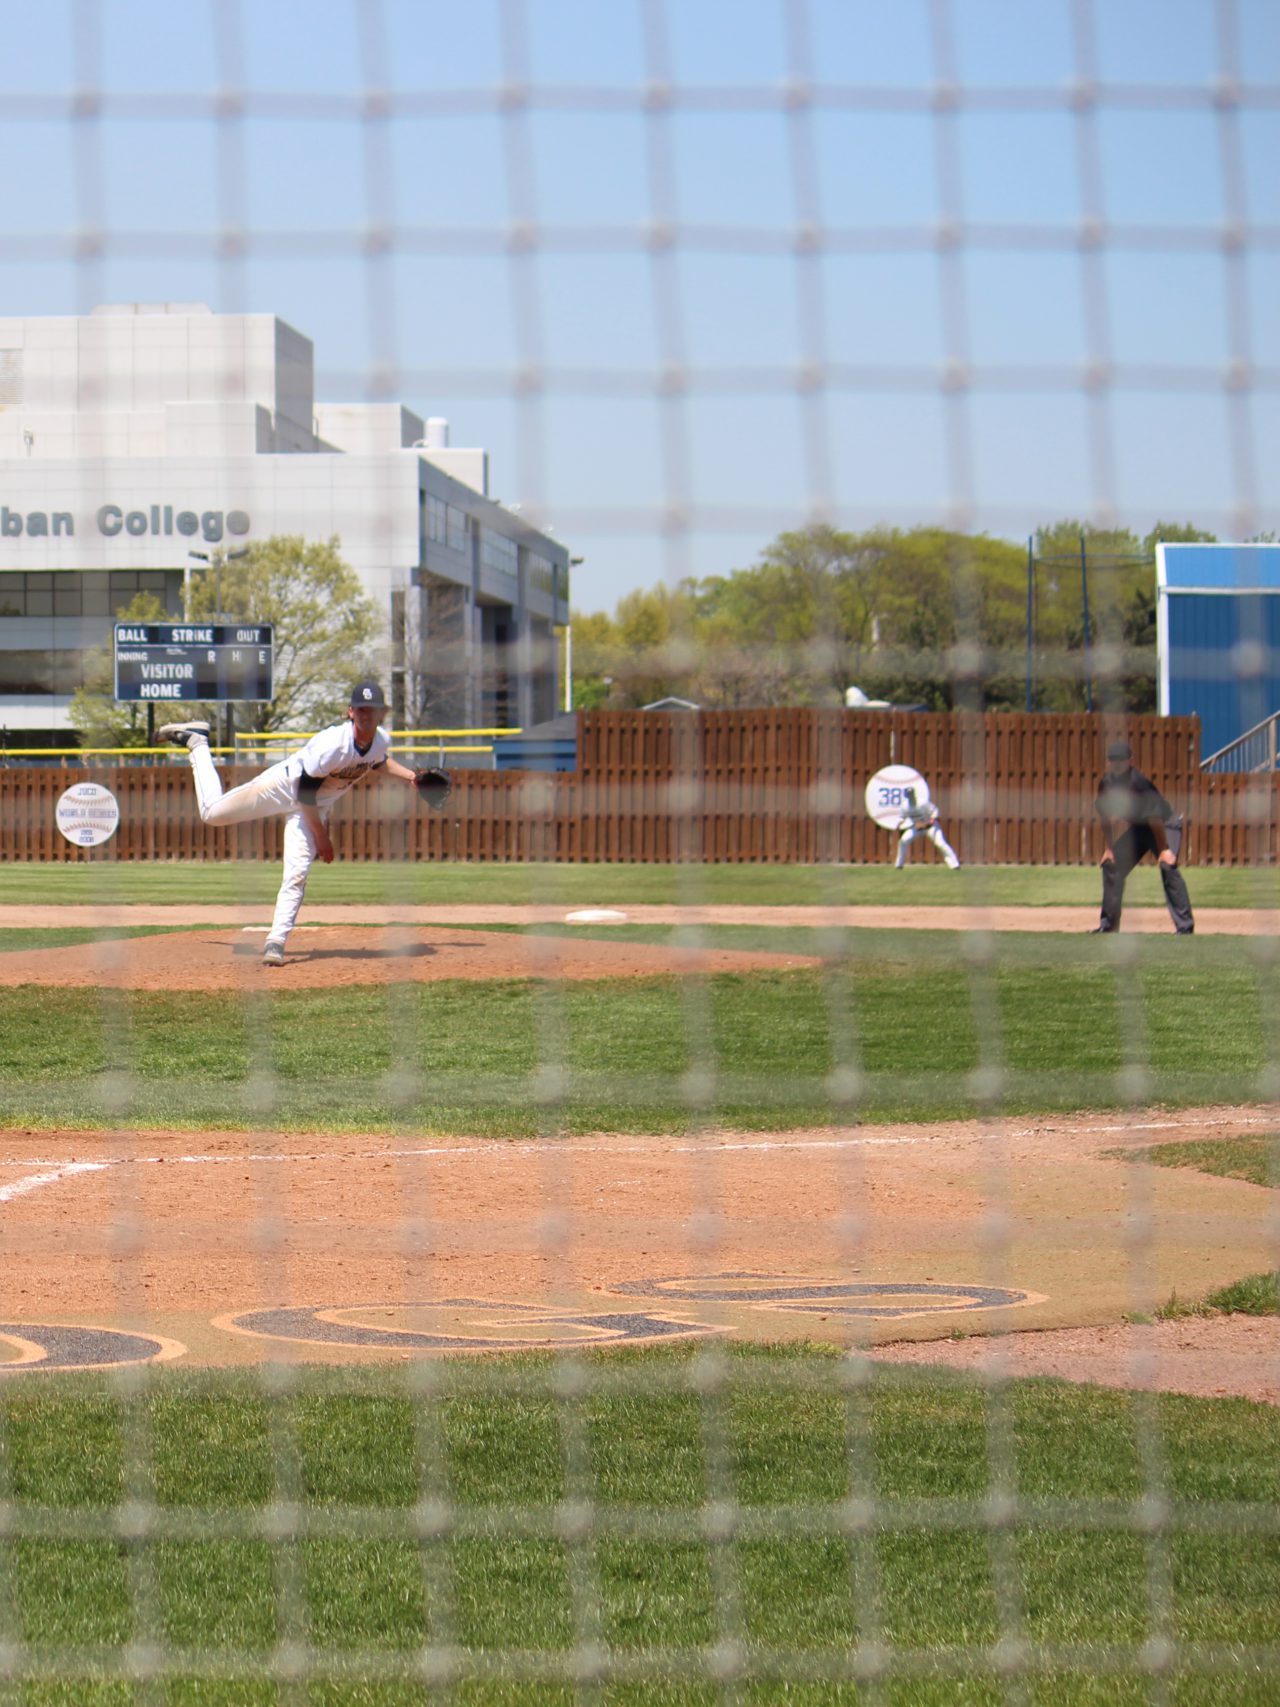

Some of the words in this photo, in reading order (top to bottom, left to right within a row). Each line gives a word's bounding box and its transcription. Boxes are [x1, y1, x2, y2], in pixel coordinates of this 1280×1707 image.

[97, 504, 250, 542] College
[118, 629, 147, 642] BALL
[172, 629, 212, 642] STRIKE
[237, 630, 260, 642] OUT
[207, 651, 216, 662] R
[141, 664, 193, 678] VISITOR
[140, 684, 181, 697] HOME
